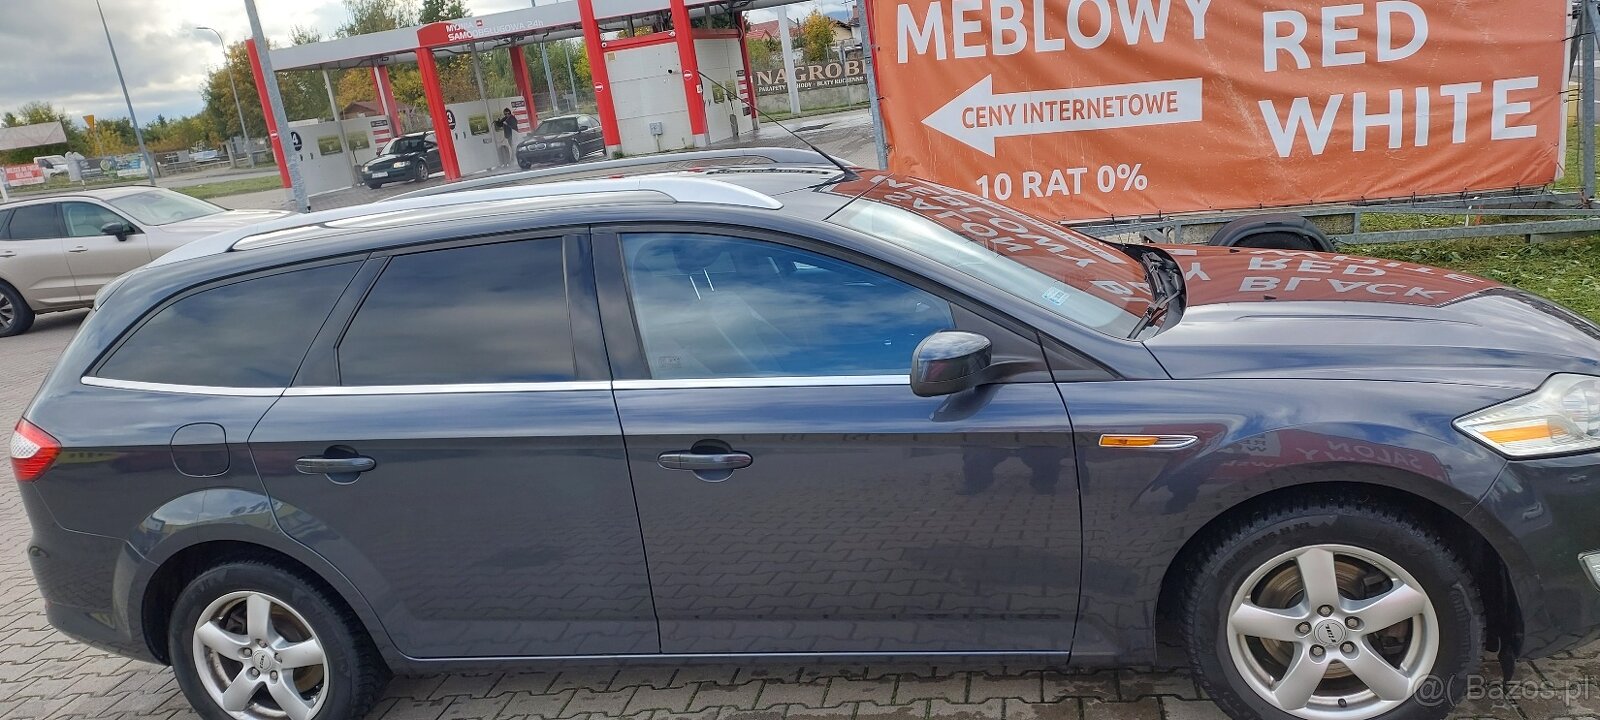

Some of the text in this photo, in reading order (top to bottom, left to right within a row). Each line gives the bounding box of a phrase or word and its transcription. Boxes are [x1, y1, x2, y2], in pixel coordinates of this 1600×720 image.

[897, 0, 1211, 63] MEBLOWY
[1263, 0, 1429, 72] RED
[446, 111, 453, 124] 3
[961, 91, 1179, 129] CENY INTERNETOWE
[1258, 76, 1539, 158] WHITE
[292, 133, 299, 146] 4
[975, 163, 1148, 200] 10 RAT 0%
